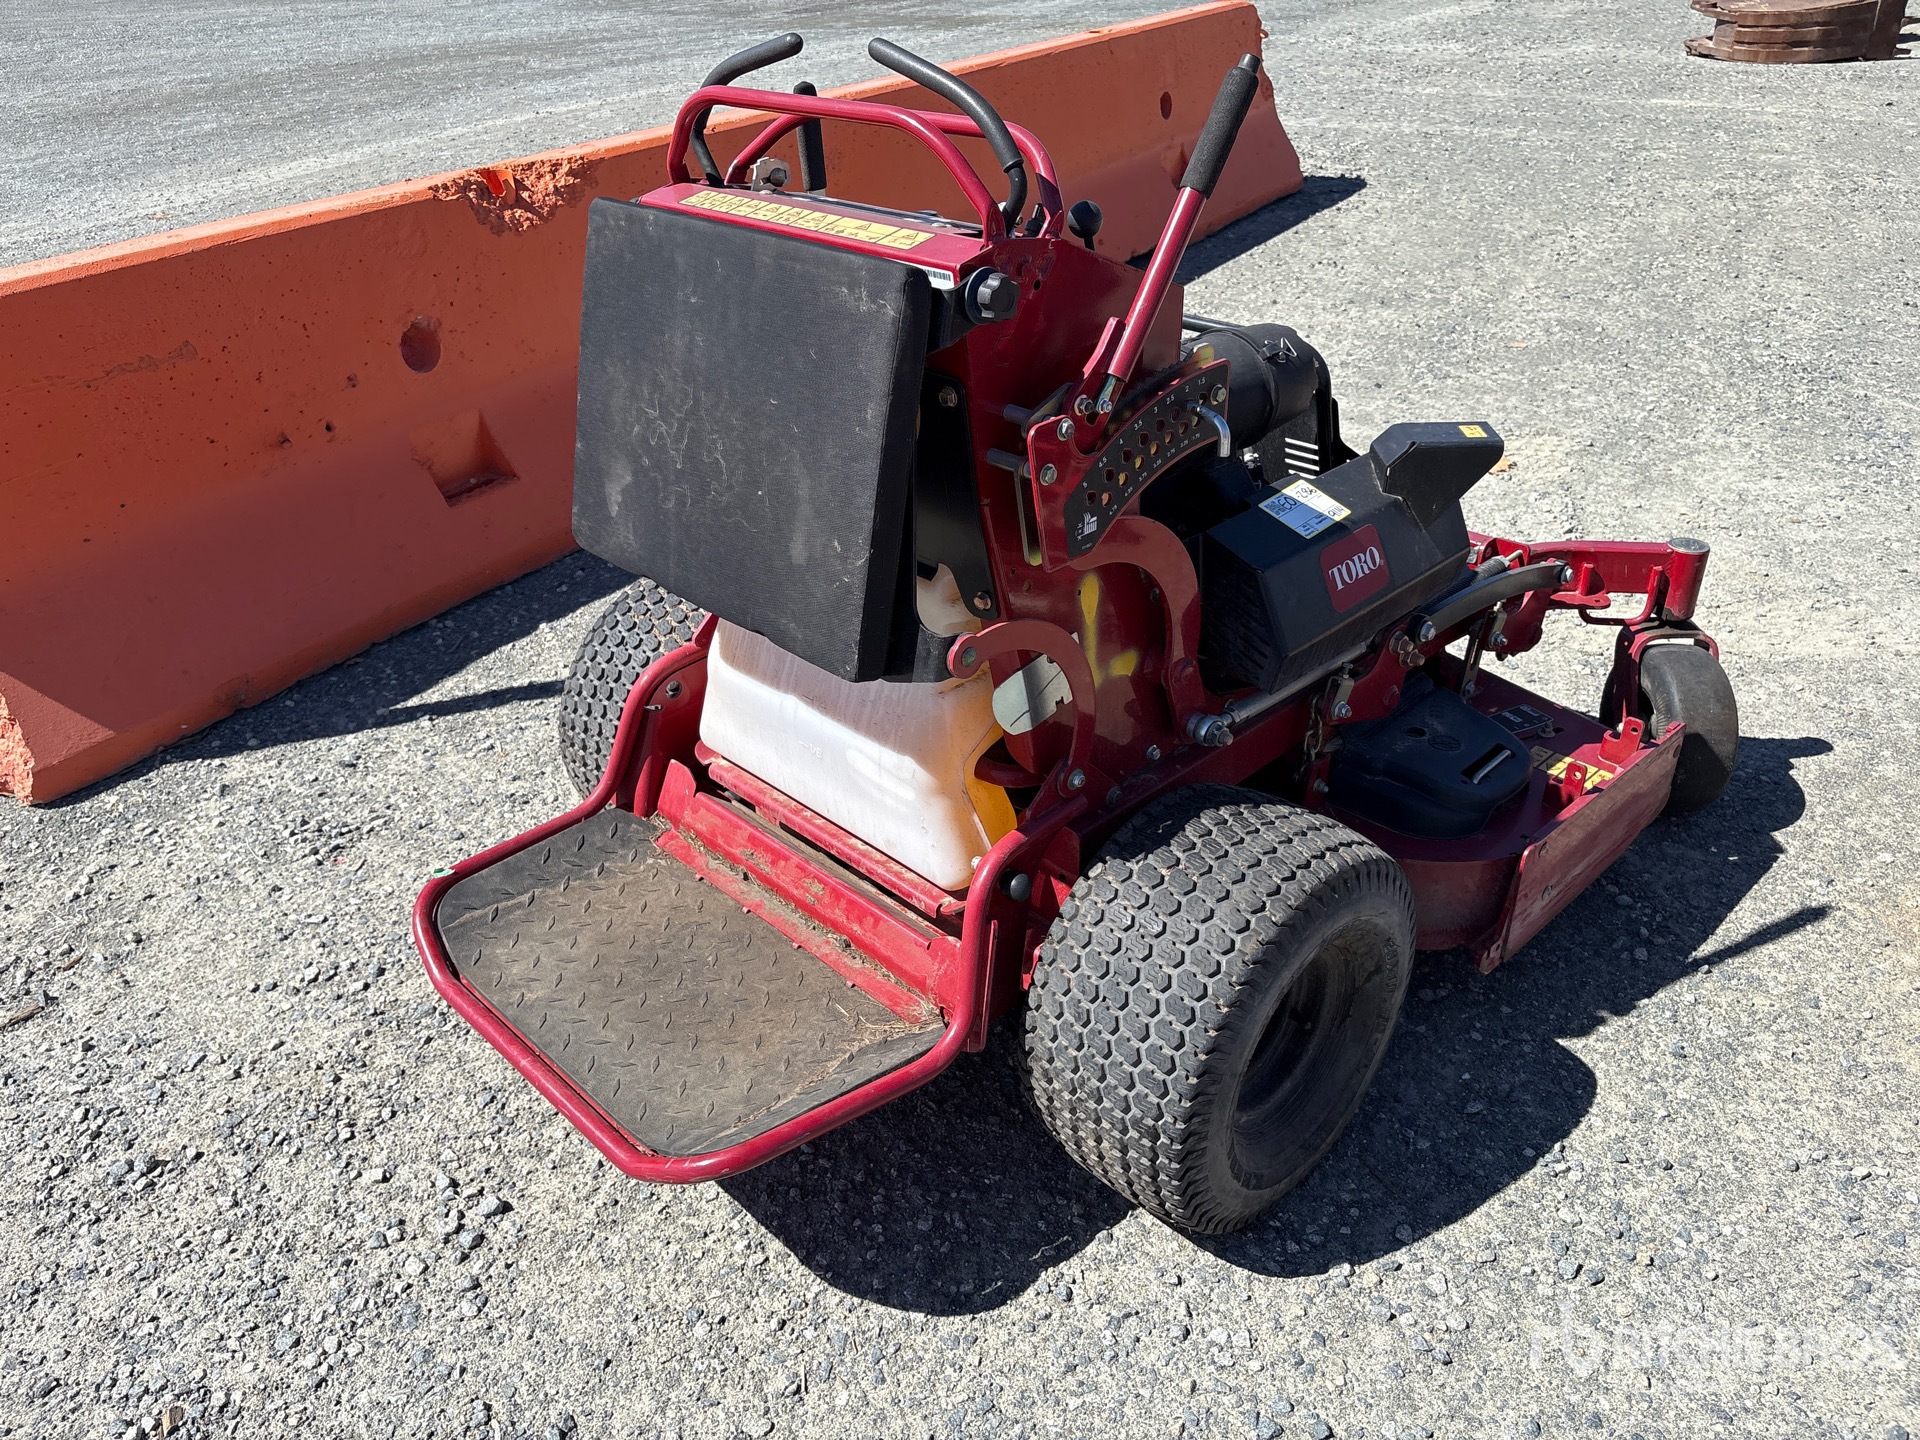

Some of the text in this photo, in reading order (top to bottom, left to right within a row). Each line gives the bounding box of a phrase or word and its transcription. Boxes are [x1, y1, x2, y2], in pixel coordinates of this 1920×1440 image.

[1134, 420, 1143, 430] 3.5
[1166, 394, 1175, 404] 2.5
[1328, 546, 1380, 592] TORO
